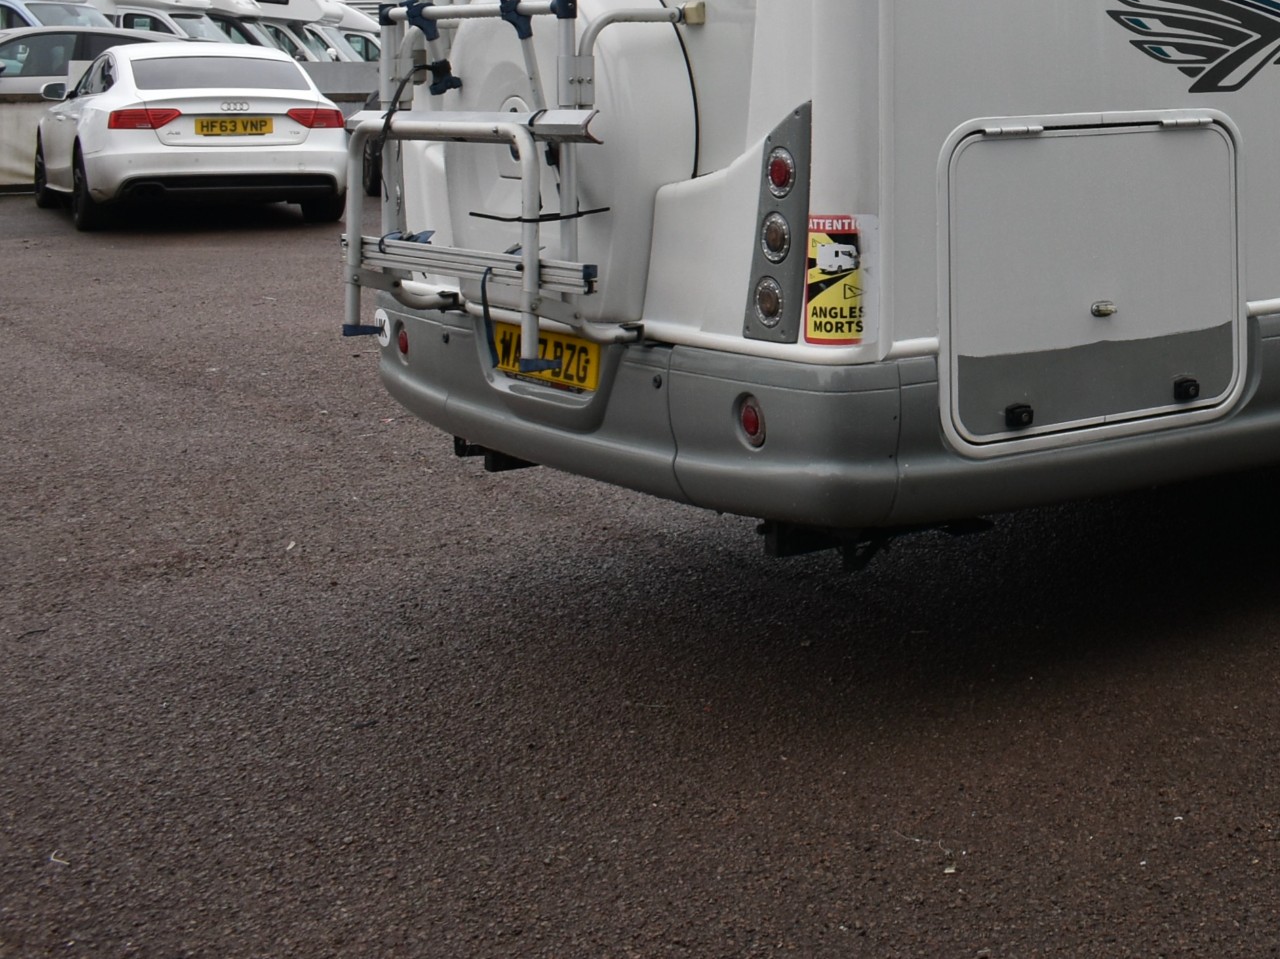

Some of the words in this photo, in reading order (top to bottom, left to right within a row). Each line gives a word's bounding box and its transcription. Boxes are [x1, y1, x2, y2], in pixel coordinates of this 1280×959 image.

[201, 120, 237, 133] HF63
[241, 120, 268, 132] VNP
[811, 305, 865, 319] ANGLES
[813, 320, 864, 333] MORTS
[501, 330, 548, 375] WA7
